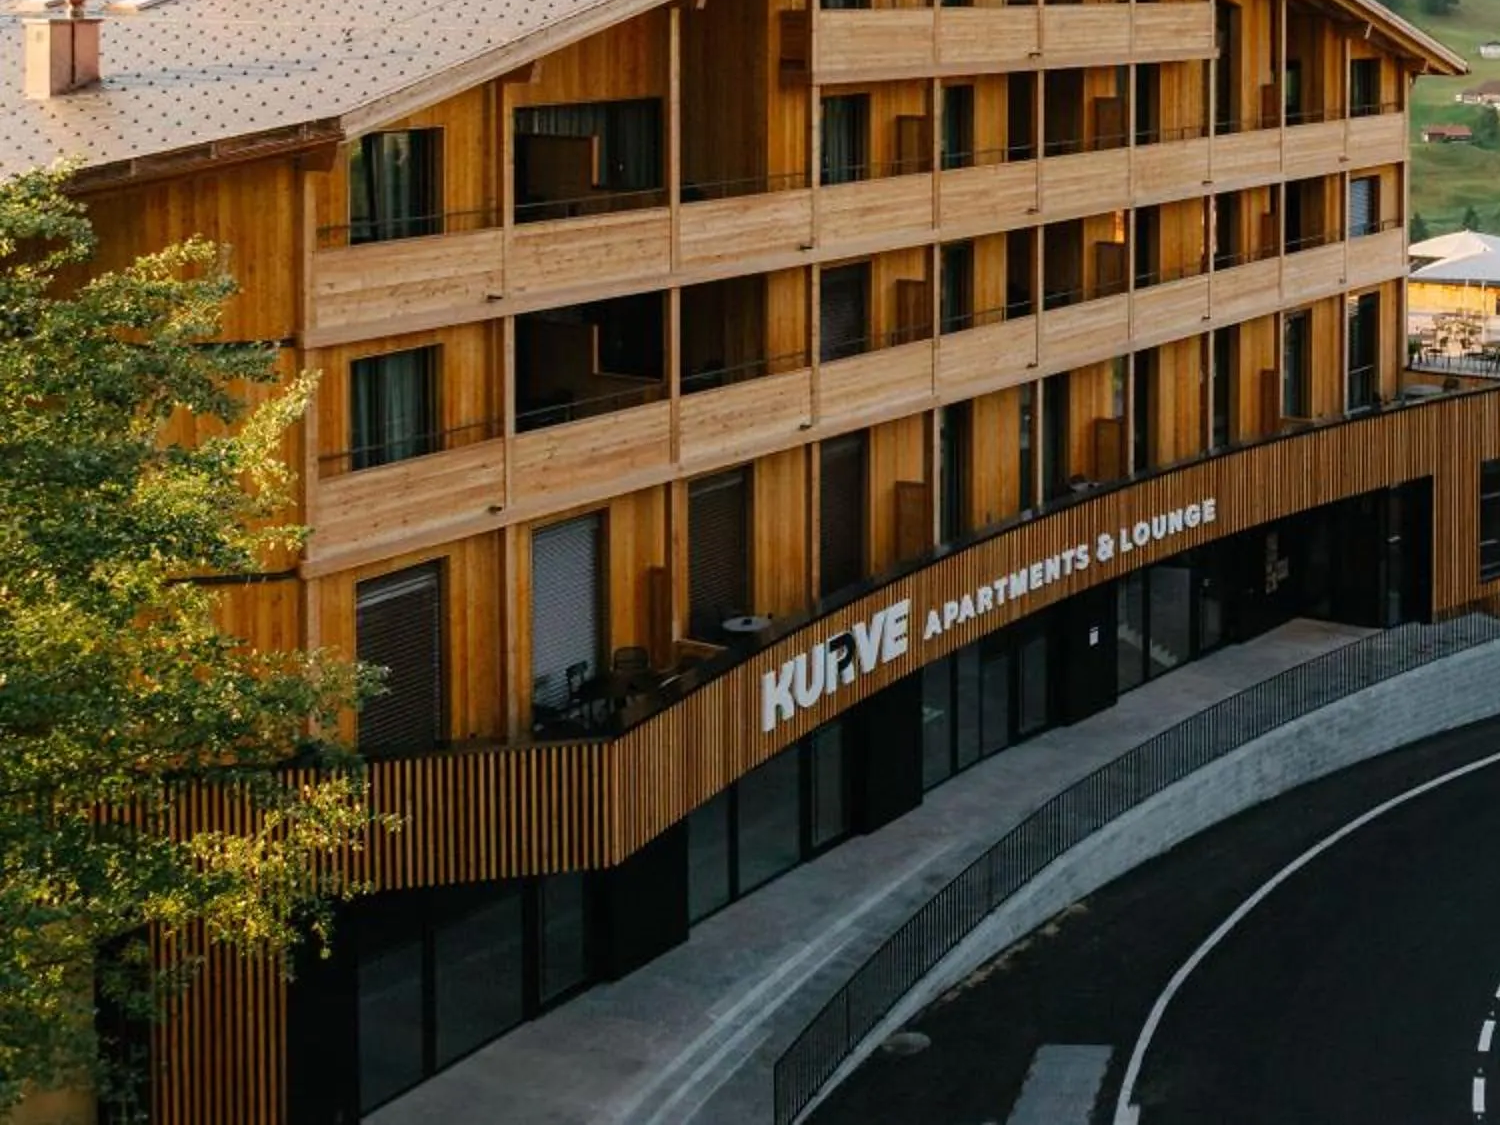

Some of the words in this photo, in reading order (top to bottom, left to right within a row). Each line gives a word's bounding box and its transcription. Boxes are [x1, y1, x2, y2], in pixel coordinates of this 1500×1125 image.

[762, 598, 911, 732] KURVE
[922, 544, 1090, 640] APARTMENTS
[1096, 533, 1115, 562] &
[1119, 498, 1216, 553] LOUNGE
